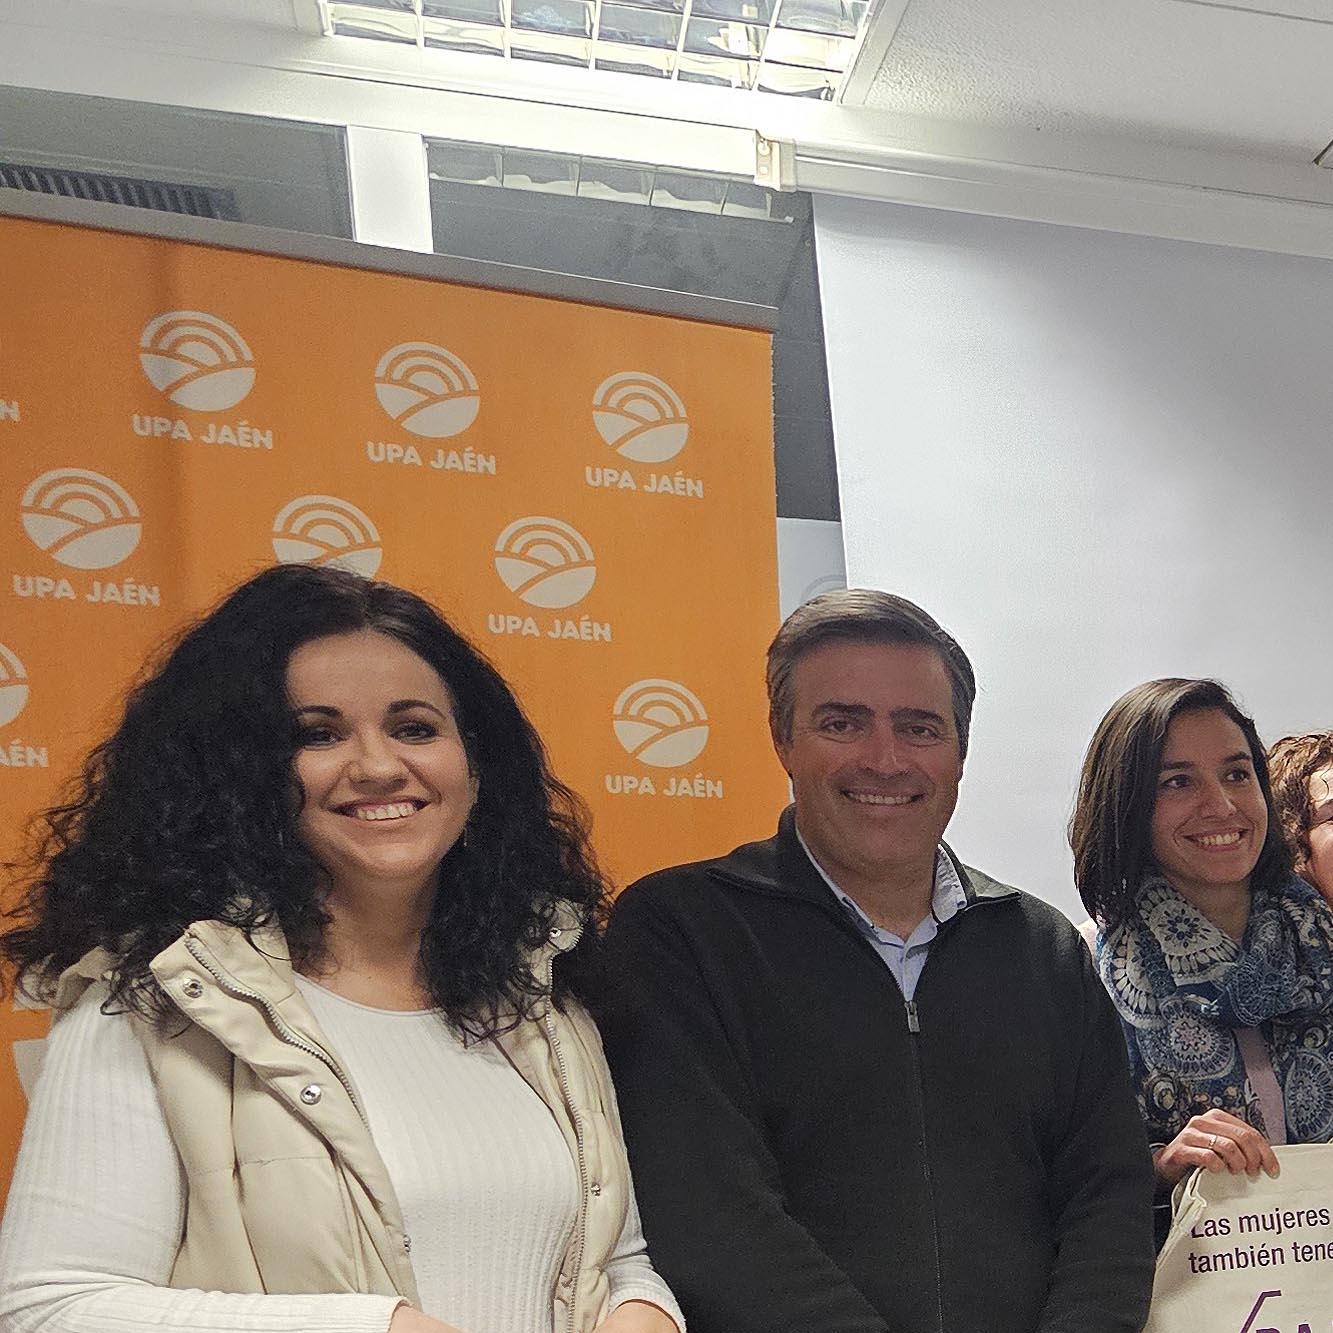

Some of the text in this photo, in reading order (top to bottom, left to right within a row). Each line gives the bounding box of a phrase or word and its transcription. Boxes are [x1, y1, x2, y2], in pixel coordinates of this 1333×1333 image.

[132, 413, 274, 450] UPA JAÉN
[366, 441, 497, 475] UPA JAÉN
[585, 466, 705, 498] UPA JAÉN
[13, 574, 160, 607] UPA JAÉN
[487, 614, 613, 643] UPA JAÉN
[605, 771, 724, 799] UPA JAÉN
[1238, 1206, 1330, 1237] mujeres
[1188, 1242, 1285, 1274] también
